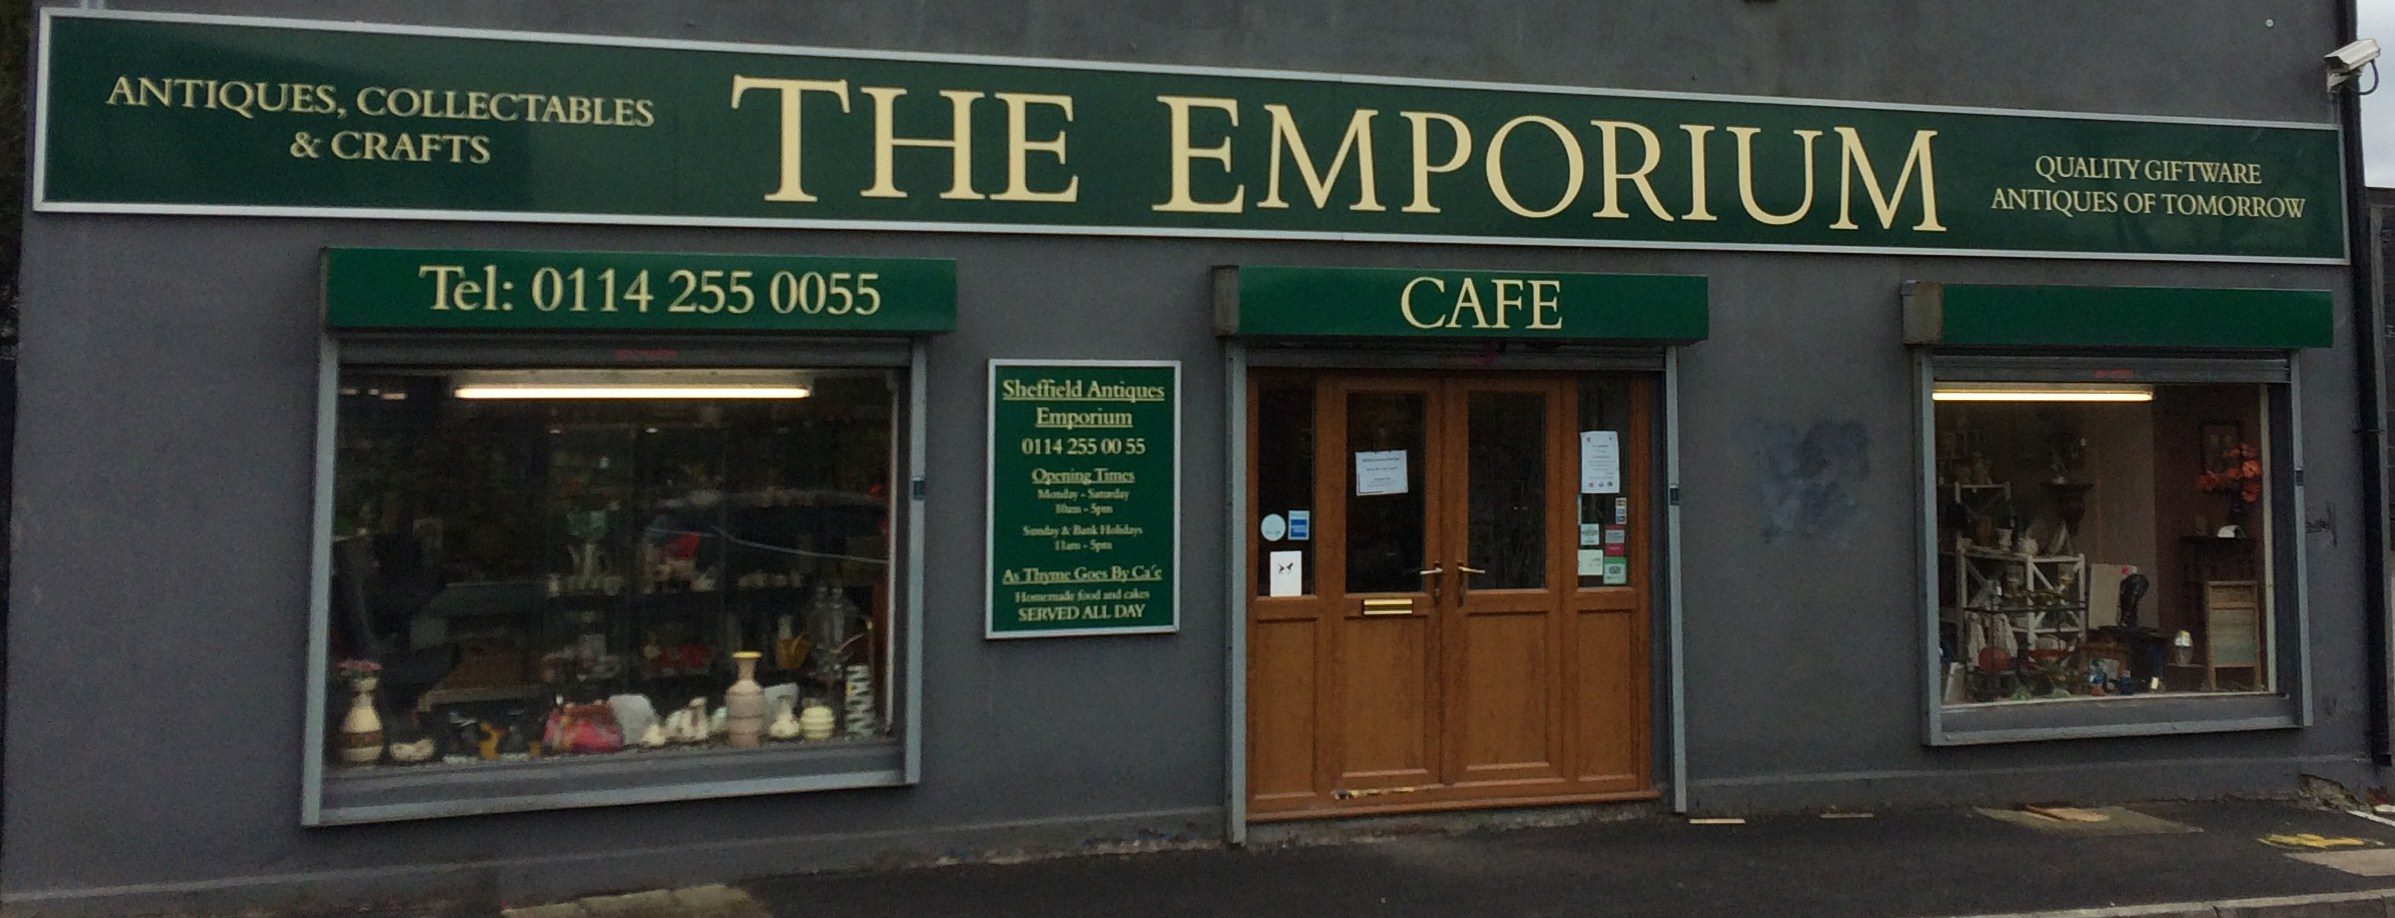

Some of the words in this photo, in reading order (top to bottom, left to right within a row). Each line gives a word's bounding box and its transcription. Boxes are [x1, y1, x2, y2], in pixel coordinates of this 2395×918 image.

[107, 76, 347, 119] ANTIQUES,
[356, 87, 655, 127] COLLECTABLES
[290, 131, 321, 159] &
[331, 131, 491, 164] CRAFTS
[731, 73, 1080, 204] THE
[1151, 94, 1948, 233] EMPORIUM
[2035, 155, 2139, 183] QUALITY
[2144, 159, 2262, 185] GIFTWARE
[1991, 187, 2118, 218] ANTIQUES
[2123, 192, 2156, 214] OF
[2160, 193, 2306, 219] TOMORROW
[419, 265, 513, 311] Tel:
[532, 268, 653, 312] 0114
[668, 269, 754, 314] 255
[770, 271, 881, 315] 0055
[1401, 274, 1562, 330] CAFE
[1002, 379, 1082, 400] Sheffield
[1088, 380, 1166, 402] Antiques
[1035, 407, 1134, 430] Emporium
[1021, 438, 1063, 454] 0114
[1067, 438, 1097, 454] 255
[1101, 438, 1122, 454] 00
[1126, 438, 1146, 454] 55
[1032, 467, 1092, 485] Opening
[1094, 467, 1135, 484] Times
[1037, 489, 1079, 501] Monday
[1087, 488, 1130, 501] Saturday
[1022, 525, 1059, 538] Sunday
[1060, 526, 1071, 535] &
[1072, 524, 1098, 535] Bank
[1003, 568, 1020, 585] As
[1022, 567, 1072, 585] Thyme
[1073, 566, 1109, 582] Goes
[1111, 565, 1130, 583] By
[1015, 589, 1075, 603] Homemade
[1077, 589, 1102, 602] food
[1103, 588, 1122, 600] and
[1123, 589, 1151, 600] cakes
[1018, 606, 1079, 622] SERVED
[1083, 605, 1111, 620] ALL
[1114, 603, 1147, 619] DAY
